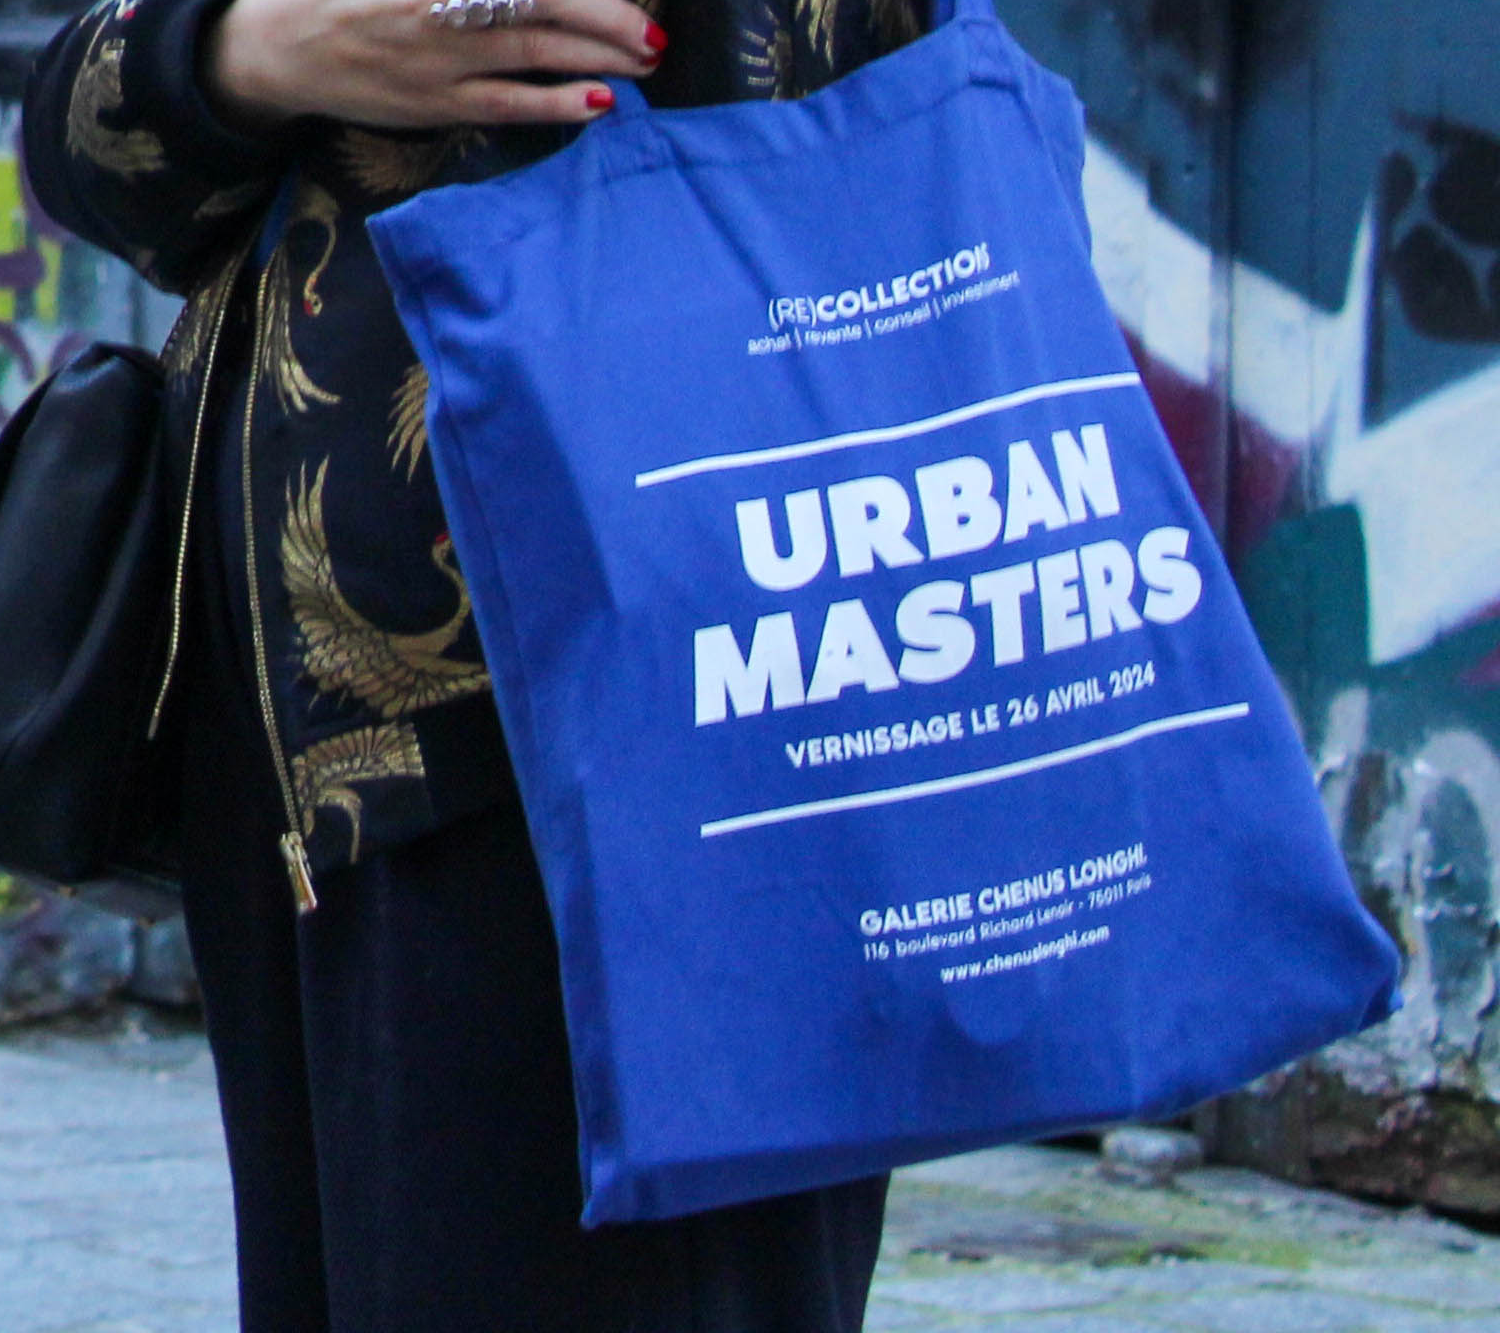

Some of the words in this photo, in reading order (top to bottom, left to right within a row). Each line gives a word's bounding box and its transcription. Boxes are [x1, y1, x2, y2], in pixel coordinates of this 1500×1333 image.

[874, 301, 932, 335] conseil
[735, 422, 1121, 593] URBAN
[694, 525, 1203, 729] MASTERS
[785, 711, 964, 769] VERNISSAGE
[970, 702, 1000, 733] LE
[1006, 695, 1039, 728] 26
[1045, 679, 1105, 718] AVRIL
[1108, 659, 1156, 699] 2024
[859, 891, 974, 937] GALERIE
[977, 867, 1066, 916] CHENUS
[863, 941, 890, 962] 116
[894, 924, 976, 959] boulevard
[979, 911, 1034, 941] Richard
